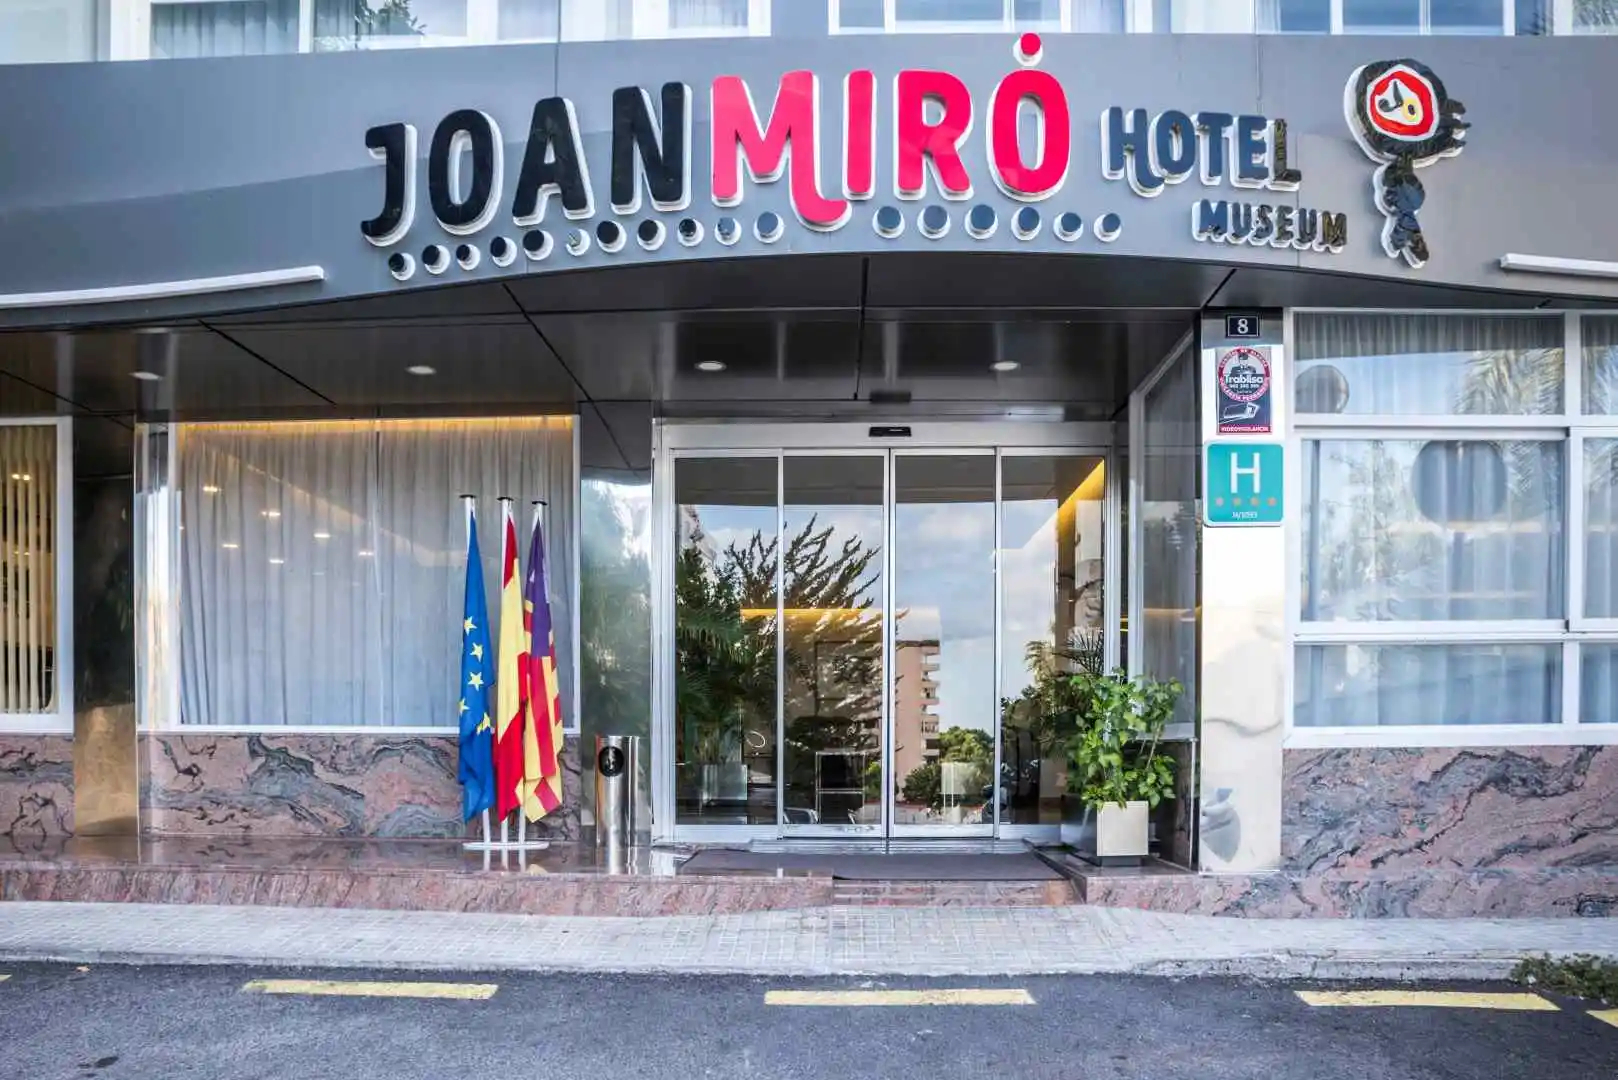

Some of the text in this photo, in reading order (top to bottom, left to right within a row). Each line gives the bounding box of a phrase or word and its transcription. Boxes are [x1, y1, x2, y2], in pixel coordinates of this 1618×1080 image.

[361, 81, 692, 247] JOAN
[1102, 106, 1302, 196] HOTEL
[1193, 198, 1348, 252] MUSEUM
[1237, 318, 1249, 334] 8
[1230, 452, 1261, 494] H
